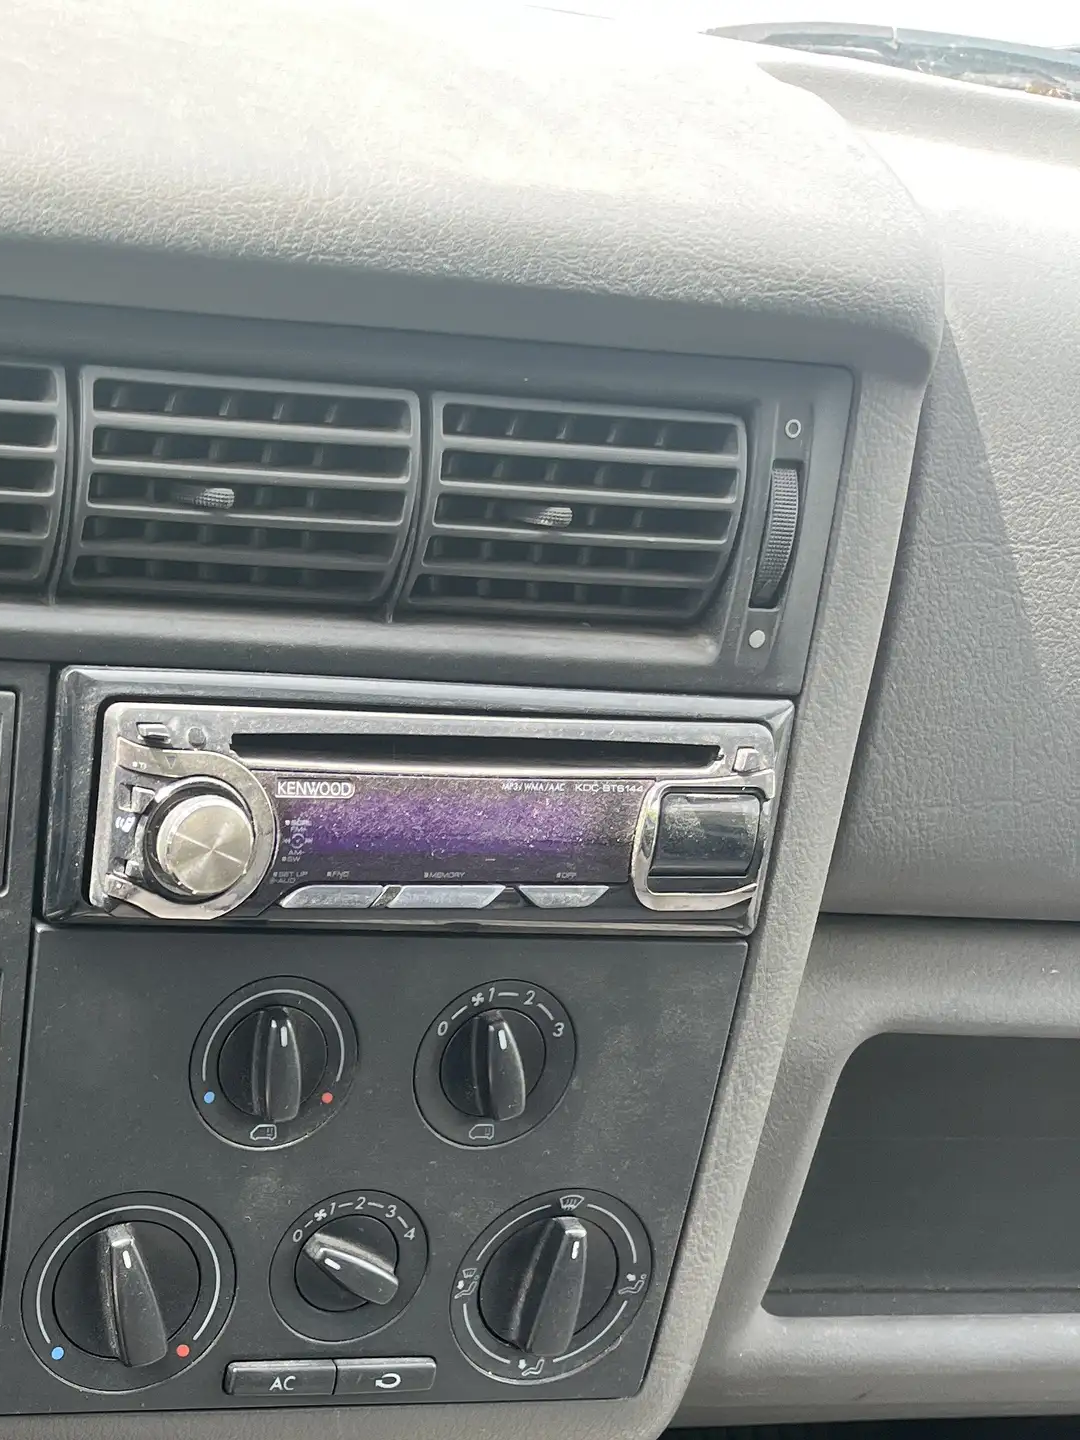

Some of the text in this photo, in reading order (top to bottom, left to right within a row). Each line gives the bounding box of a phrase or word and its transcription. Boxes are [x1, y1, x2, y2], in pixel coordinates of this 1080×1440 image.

[277, 781, 352, 796] KENWOOD
[437, 987, 565, 1037] 0 1 2 3
[292, 1196, 416, 1242] 0 1 2 3 4
[269, 1375, 297, 1391] AC
